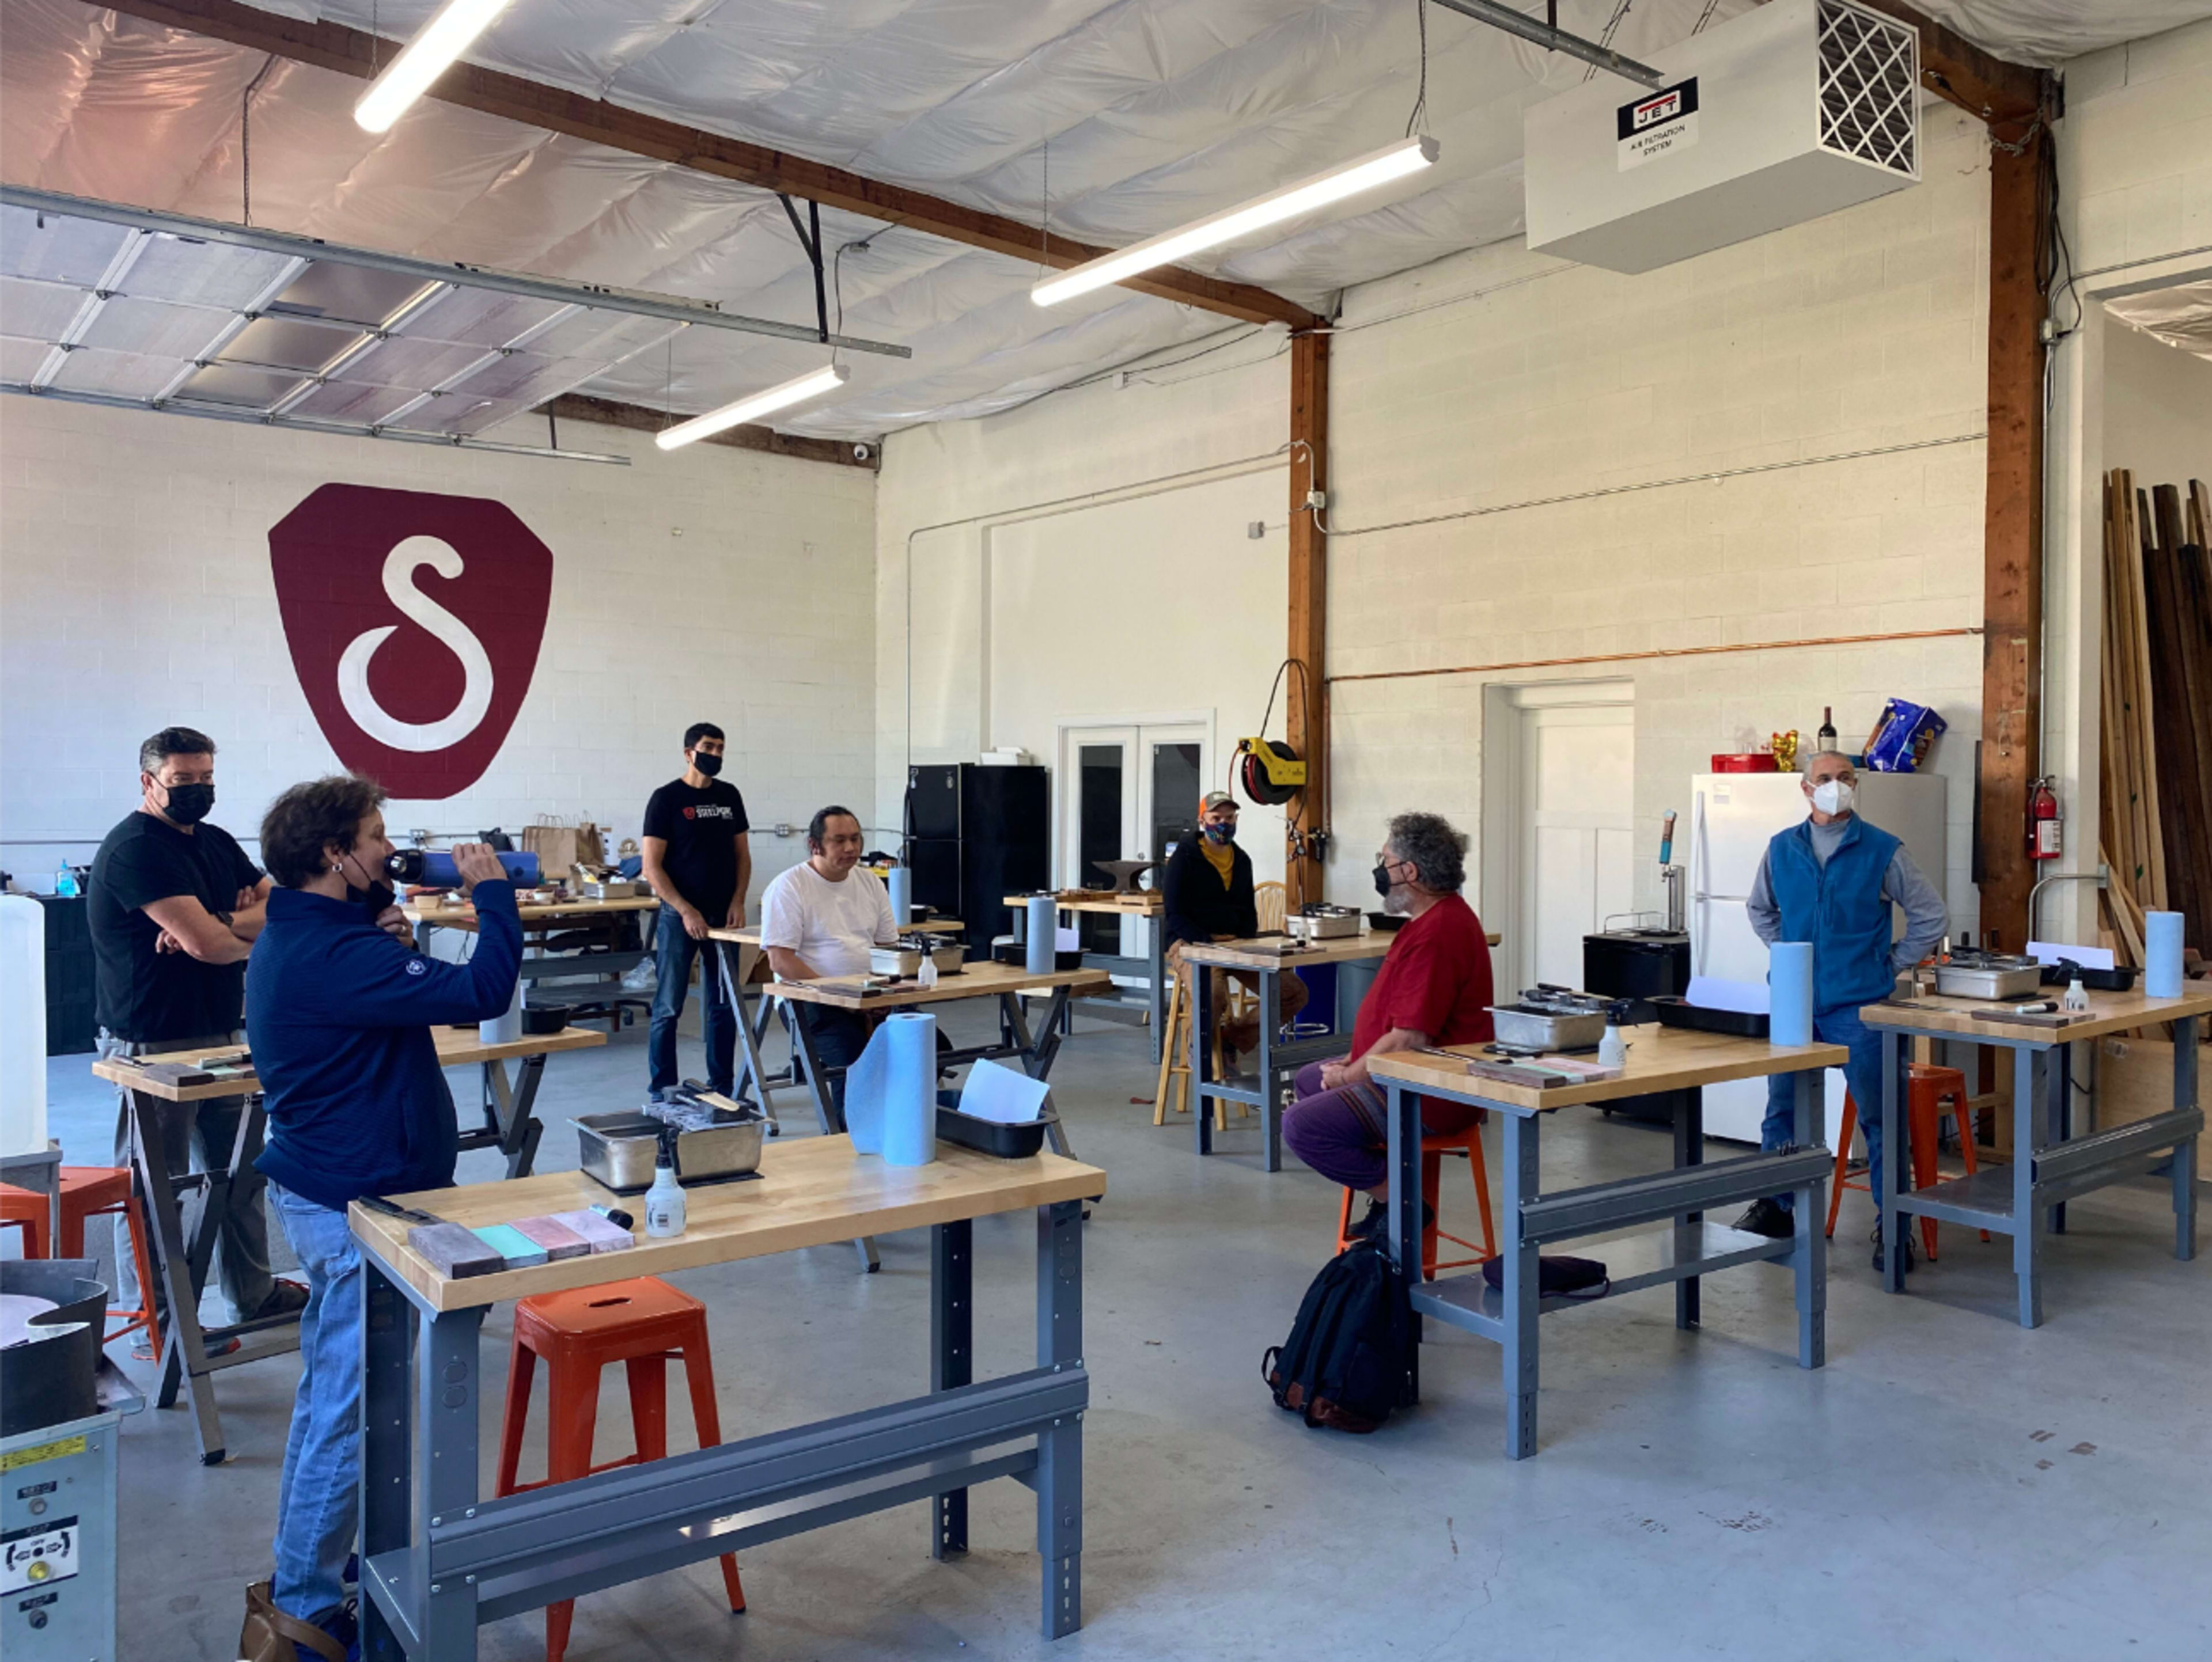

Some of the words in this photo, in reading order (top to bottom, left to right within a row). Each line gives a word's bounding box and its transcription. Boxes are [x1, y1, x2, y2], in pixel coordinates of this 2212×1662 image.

[1639, 101, 1676, 123] JET
[1631, 141, 1642, 150] AIR
[1645, 125, 1685, 144] FILTRATION
[1644, 140, 1672, 155] SYSTEM
[338, 535, 494, 752] S
